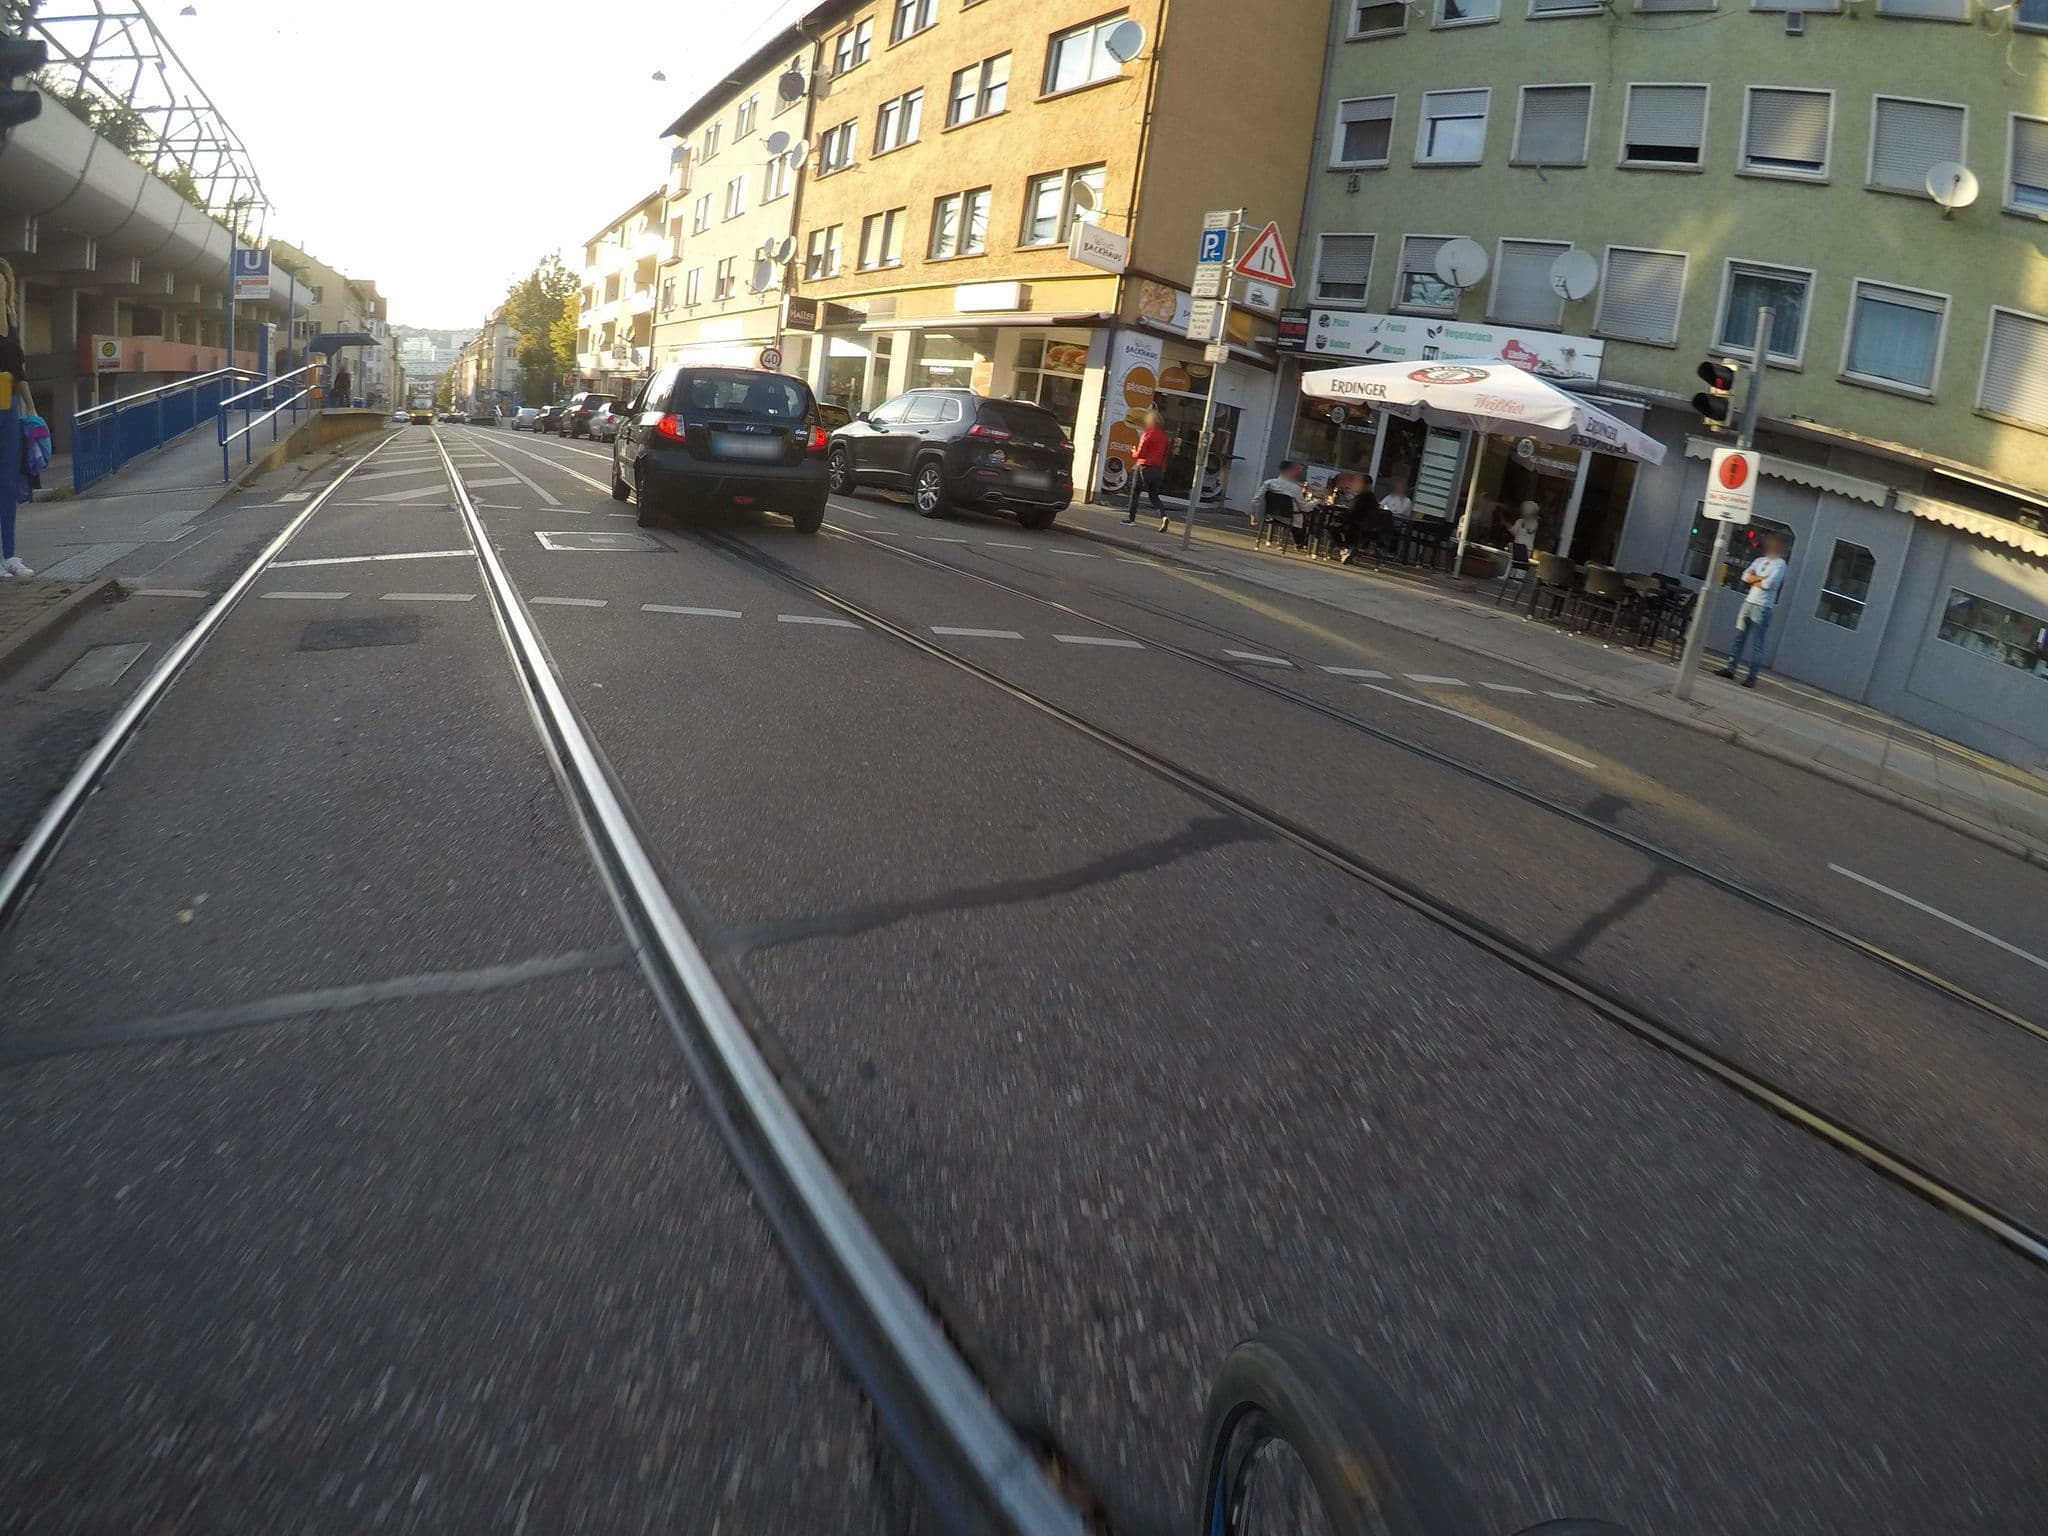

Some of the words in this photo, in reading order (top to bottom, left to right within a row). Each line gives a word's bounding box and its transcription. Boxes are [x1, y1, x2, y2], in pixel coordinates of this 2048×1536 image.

[1083, 241, 1122, 262] BACKHAUS
[1202, 233, 1220, 259] P
[244, 250, 262, 270] U
[790, 309, 816, 321] HALLER
[764, 354, 779, 365] 40
[1124, 345, 1159, 360] BACKHAUS
[1330, 378, 1388, 399] ERDINGER
[1584, 416, 1619, 441] ERDINGER
